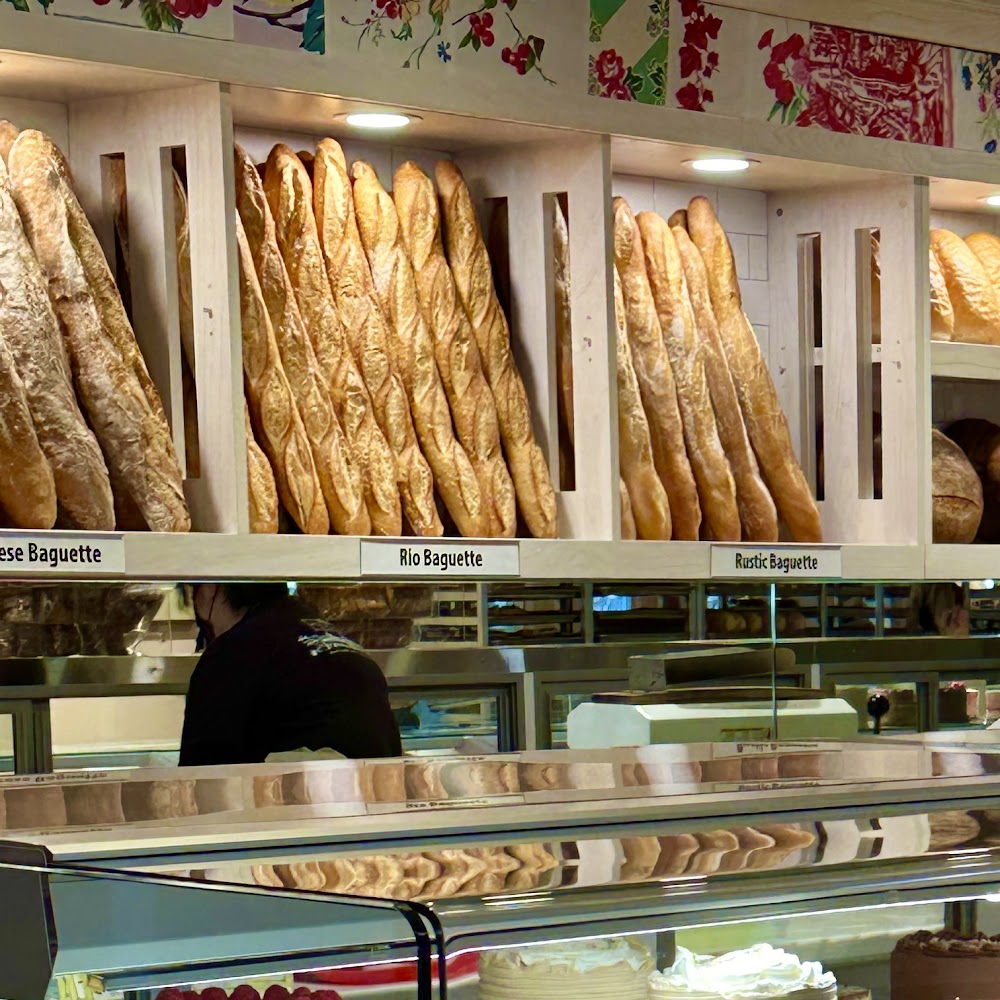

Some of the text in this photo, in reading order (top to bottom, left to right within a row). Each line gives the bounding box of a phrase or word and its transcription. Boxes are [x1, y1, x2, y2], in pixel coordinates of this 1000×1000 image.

[28, 542, 102, 568] Baguette
[400, 548, 483, 571] Rio Baguette
[735, 553, 818, 574] Rustic Baguette
